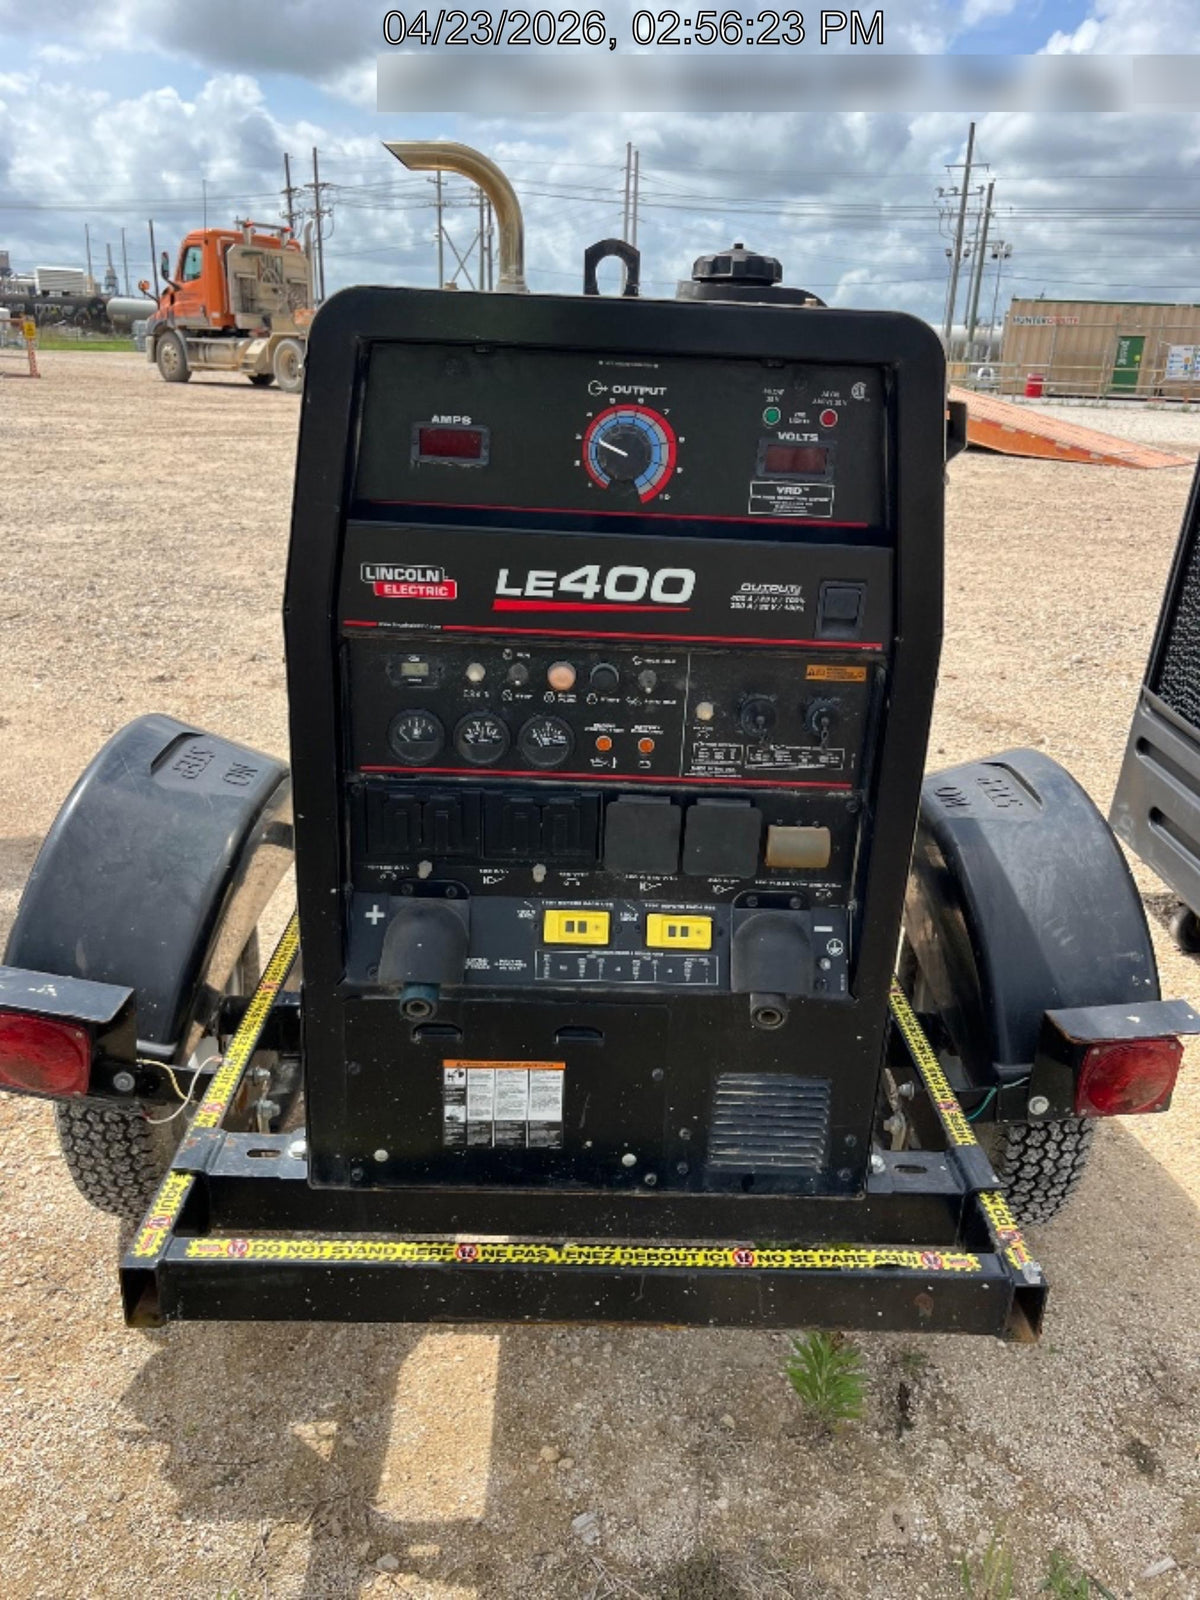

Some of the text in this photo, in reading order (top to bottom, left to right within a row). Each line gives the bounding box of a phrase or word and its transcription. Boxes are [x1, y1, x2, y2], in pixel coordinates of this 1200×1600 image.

[612, 385, 667, 395] OUTPUT
[432, 414, 472, 425] AMPS
[778, 431, 818, 442] VOLTS
[365, 567, 440, 582] LINCOLN
[384, 584, 449, 597] ELECTRIC
[495, 565, 696, 603] LE400
[741, 583, 803, 593] OUTPUT
[993, 1208, 1009, 1226] DO
[252, 1243, 282, 1254] DO
[286, 1244, 326, 1255] NOT
[332, 1245, 397, 1256] STAND
[402, 1246, 454, 1257] HERE
[481, 1248, 507, 1258] NE
[512, 1249, 549, 1259] PAS
[557, 1250, 617, 1260] TENEZ
[620, 1251, 700, 1262] DEBOUT
[703, 1253, 729, 1263] ICI
[757, 1253, 786, 1263] NO
[790, 1254, 816, 1263] SE
[819, 1254, 869, 1263] PARE
